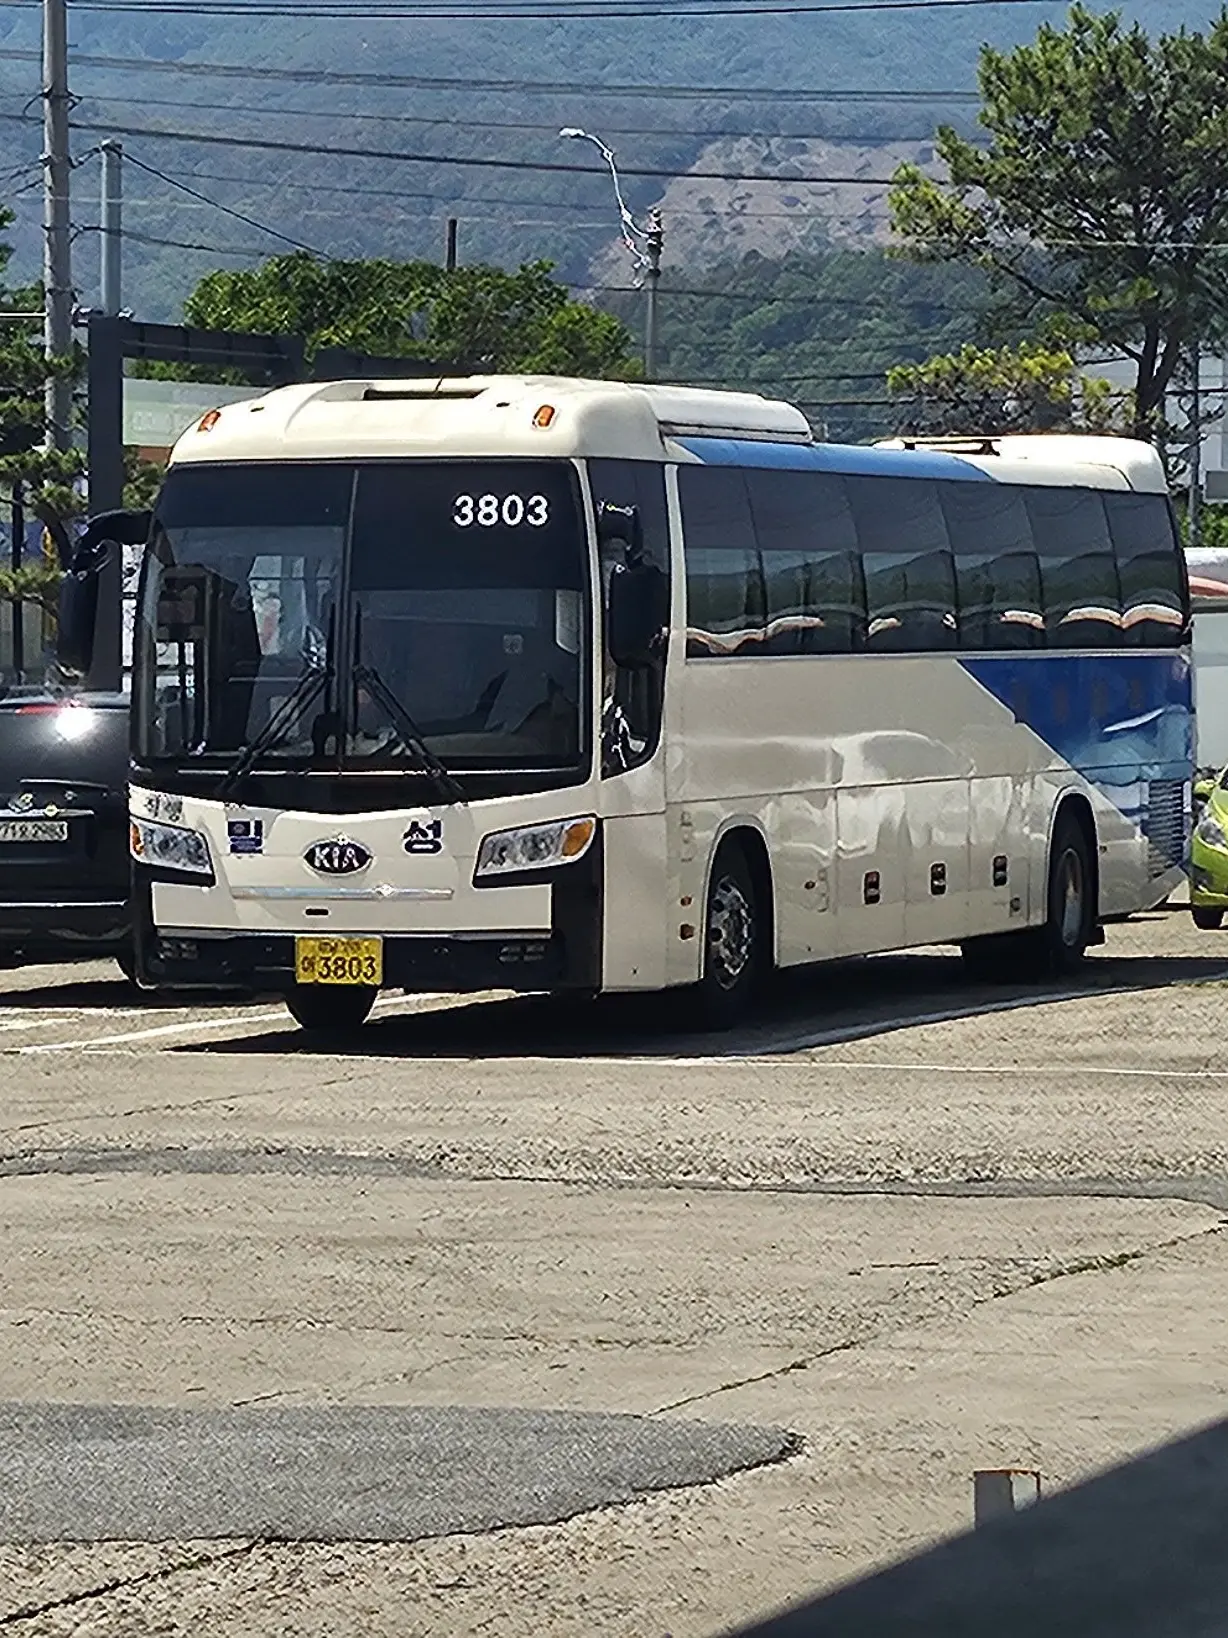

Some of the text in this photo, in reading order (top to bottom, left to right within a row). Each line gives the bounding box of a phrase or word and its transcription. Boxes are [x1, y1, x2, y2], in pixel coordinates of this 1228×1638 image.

[453, 494, 549, 527] 3803
[403, 819, 443, 854] 성
[313, 846, 360, 869] KIA
[317, 955, 376, 981] 3803
